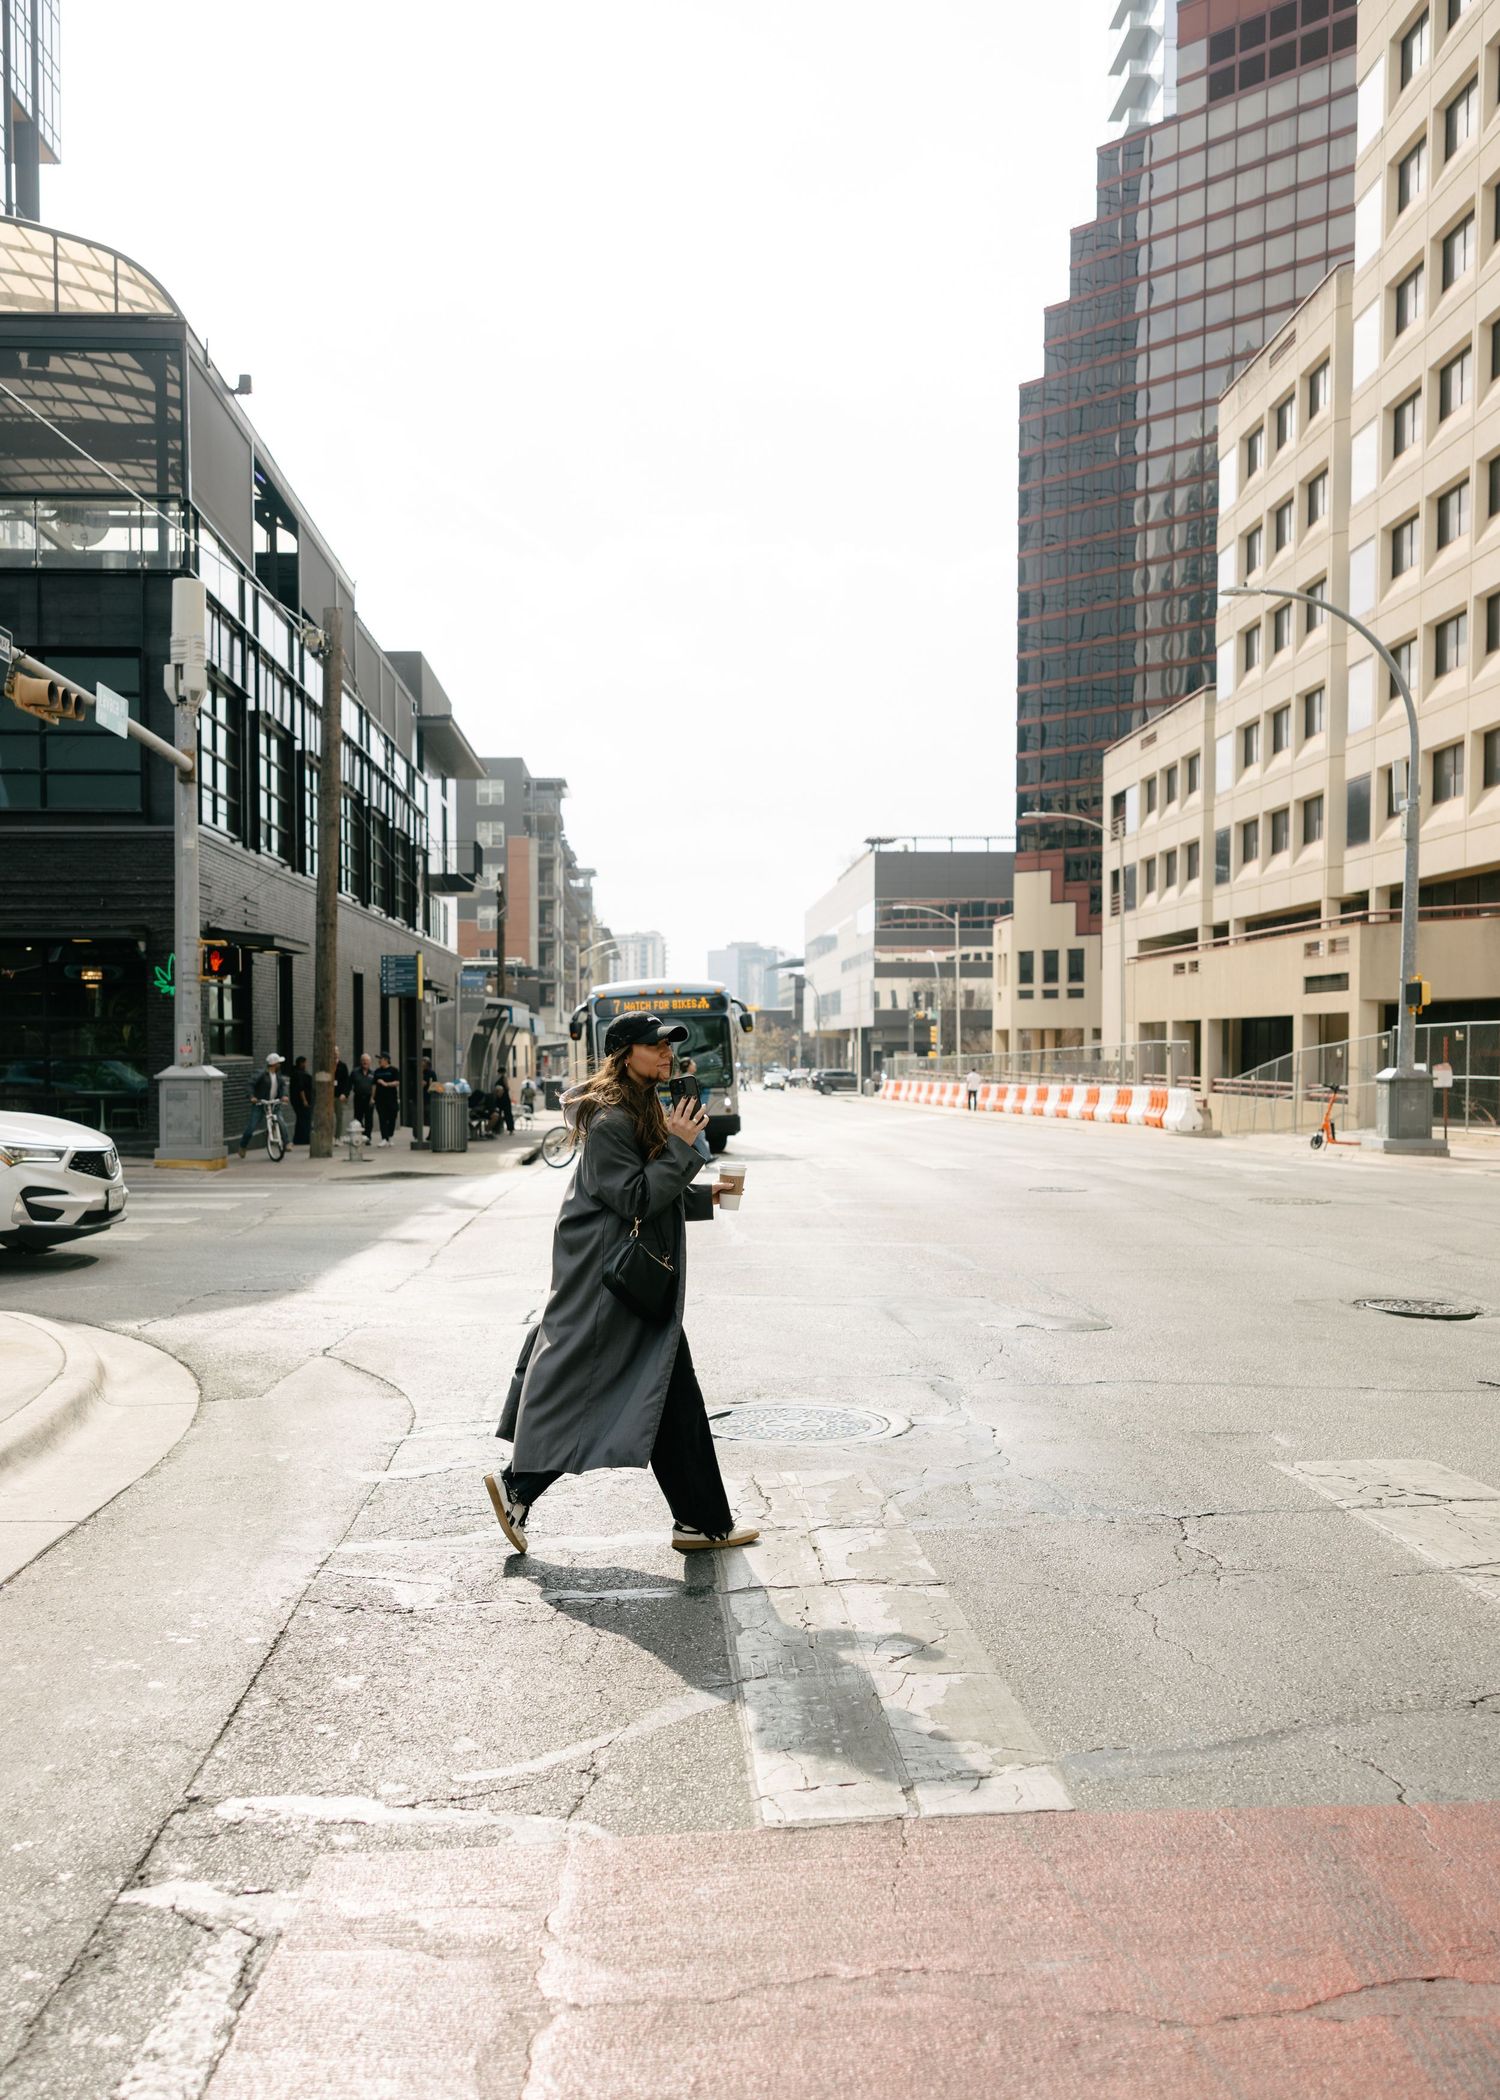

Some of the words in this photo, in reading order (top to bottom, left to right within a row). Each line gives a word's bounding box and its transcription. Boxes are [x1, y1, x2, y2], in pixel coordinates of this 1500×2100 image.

[613, 999, 621, 1014] 7
[624, 1000, 651, 1011] WATCH
[654, 999, 670, 1010] FOR
[672, 998, 697, 1009] BIKES
